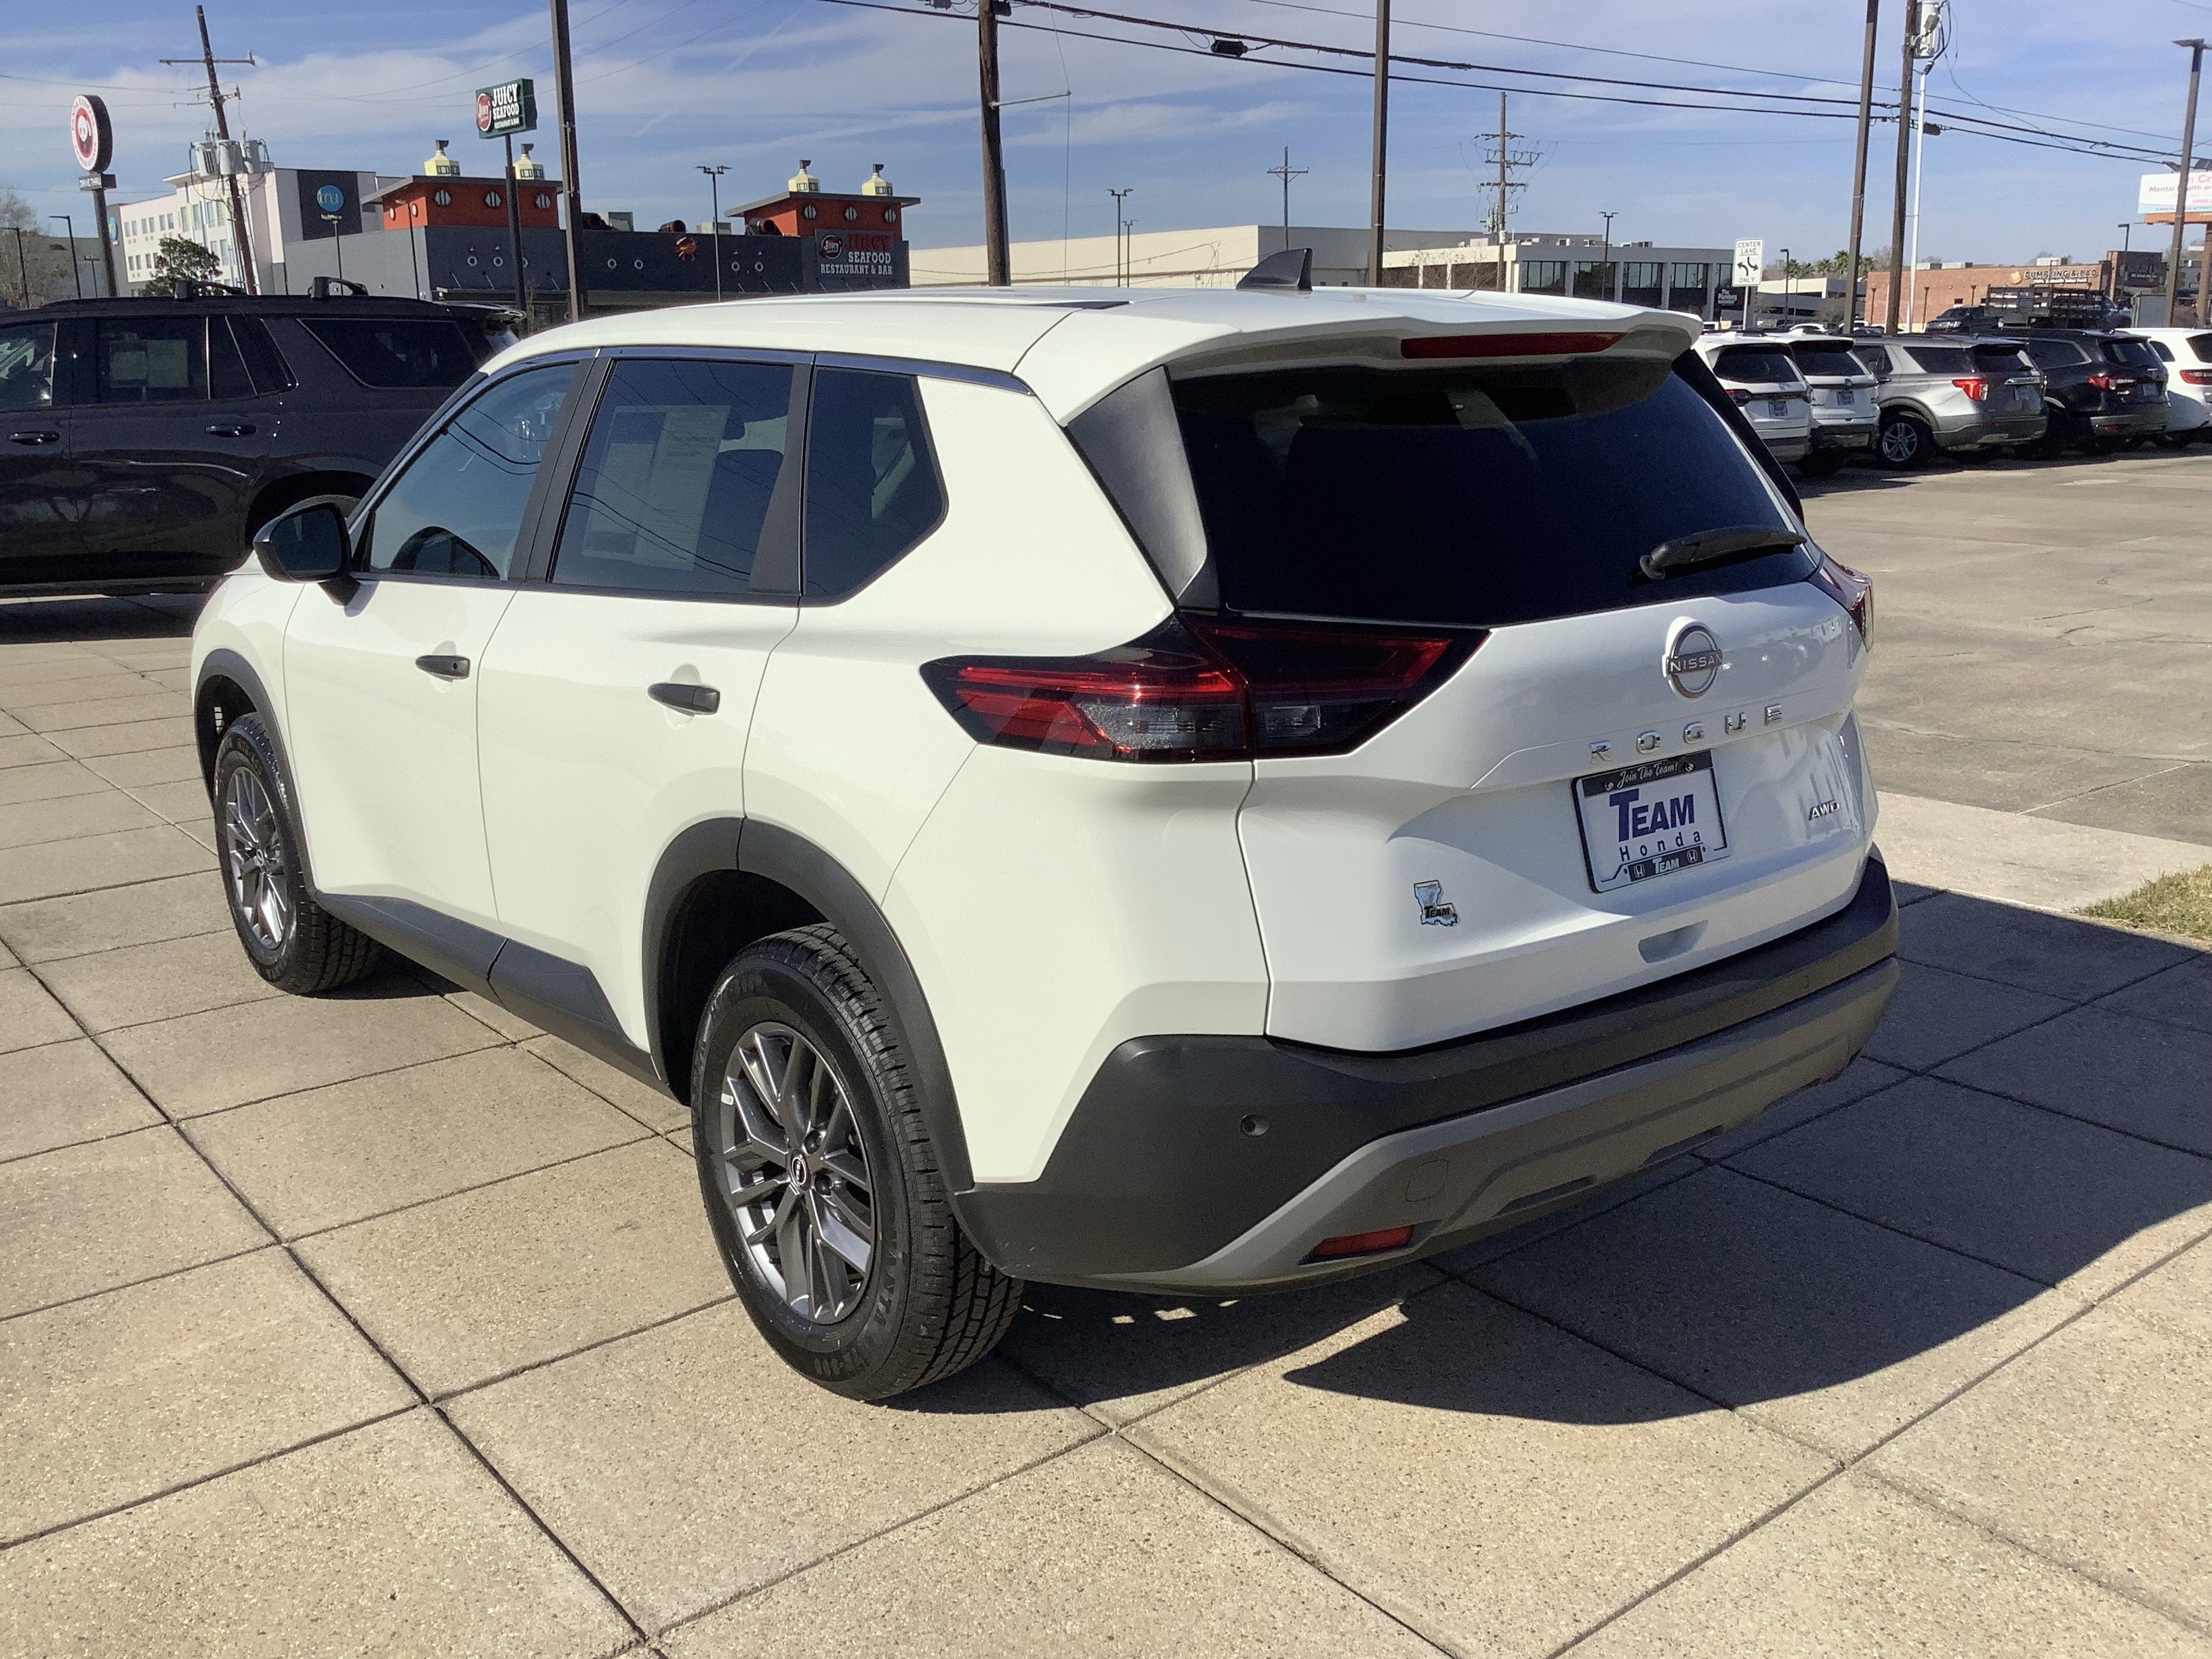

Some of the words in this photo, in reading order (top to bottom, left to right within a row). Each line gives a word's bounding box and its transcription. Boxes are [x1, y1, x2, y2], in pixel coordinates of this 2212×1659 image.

[492, 83, 518, 107] JUICY
[493, 103, 520, 121] SEAFOOD
[846, 234, 890, 251] JUICY
[848, 251, 891, 264] SEAFOOD
[820, 263, 869, 274] RESTAURANT
[871, 265, 876, 274] &
[878, 265, 893, 275] BAR
[2025, 270, 2071, 279] DUMPING
[2078, 269, 2098, 278] BAO
[1670, 653, 1722, 672] NISSAN
[1590, 703, 1783, 764] ROGUE
[1617, 771, 1637, 788] Join
[1637, 766, 1653, 779] The
[1654, 762, 1679, 777] Team!
[1609, 788, 1695, 842] TEAM
[1809, 800, 1840, 821] AWD
[1619, 831, 1702, 861] Honda
[1652, 857, 1679, 874] TEAM
[1424, 905, 1450, 919] TEAM
